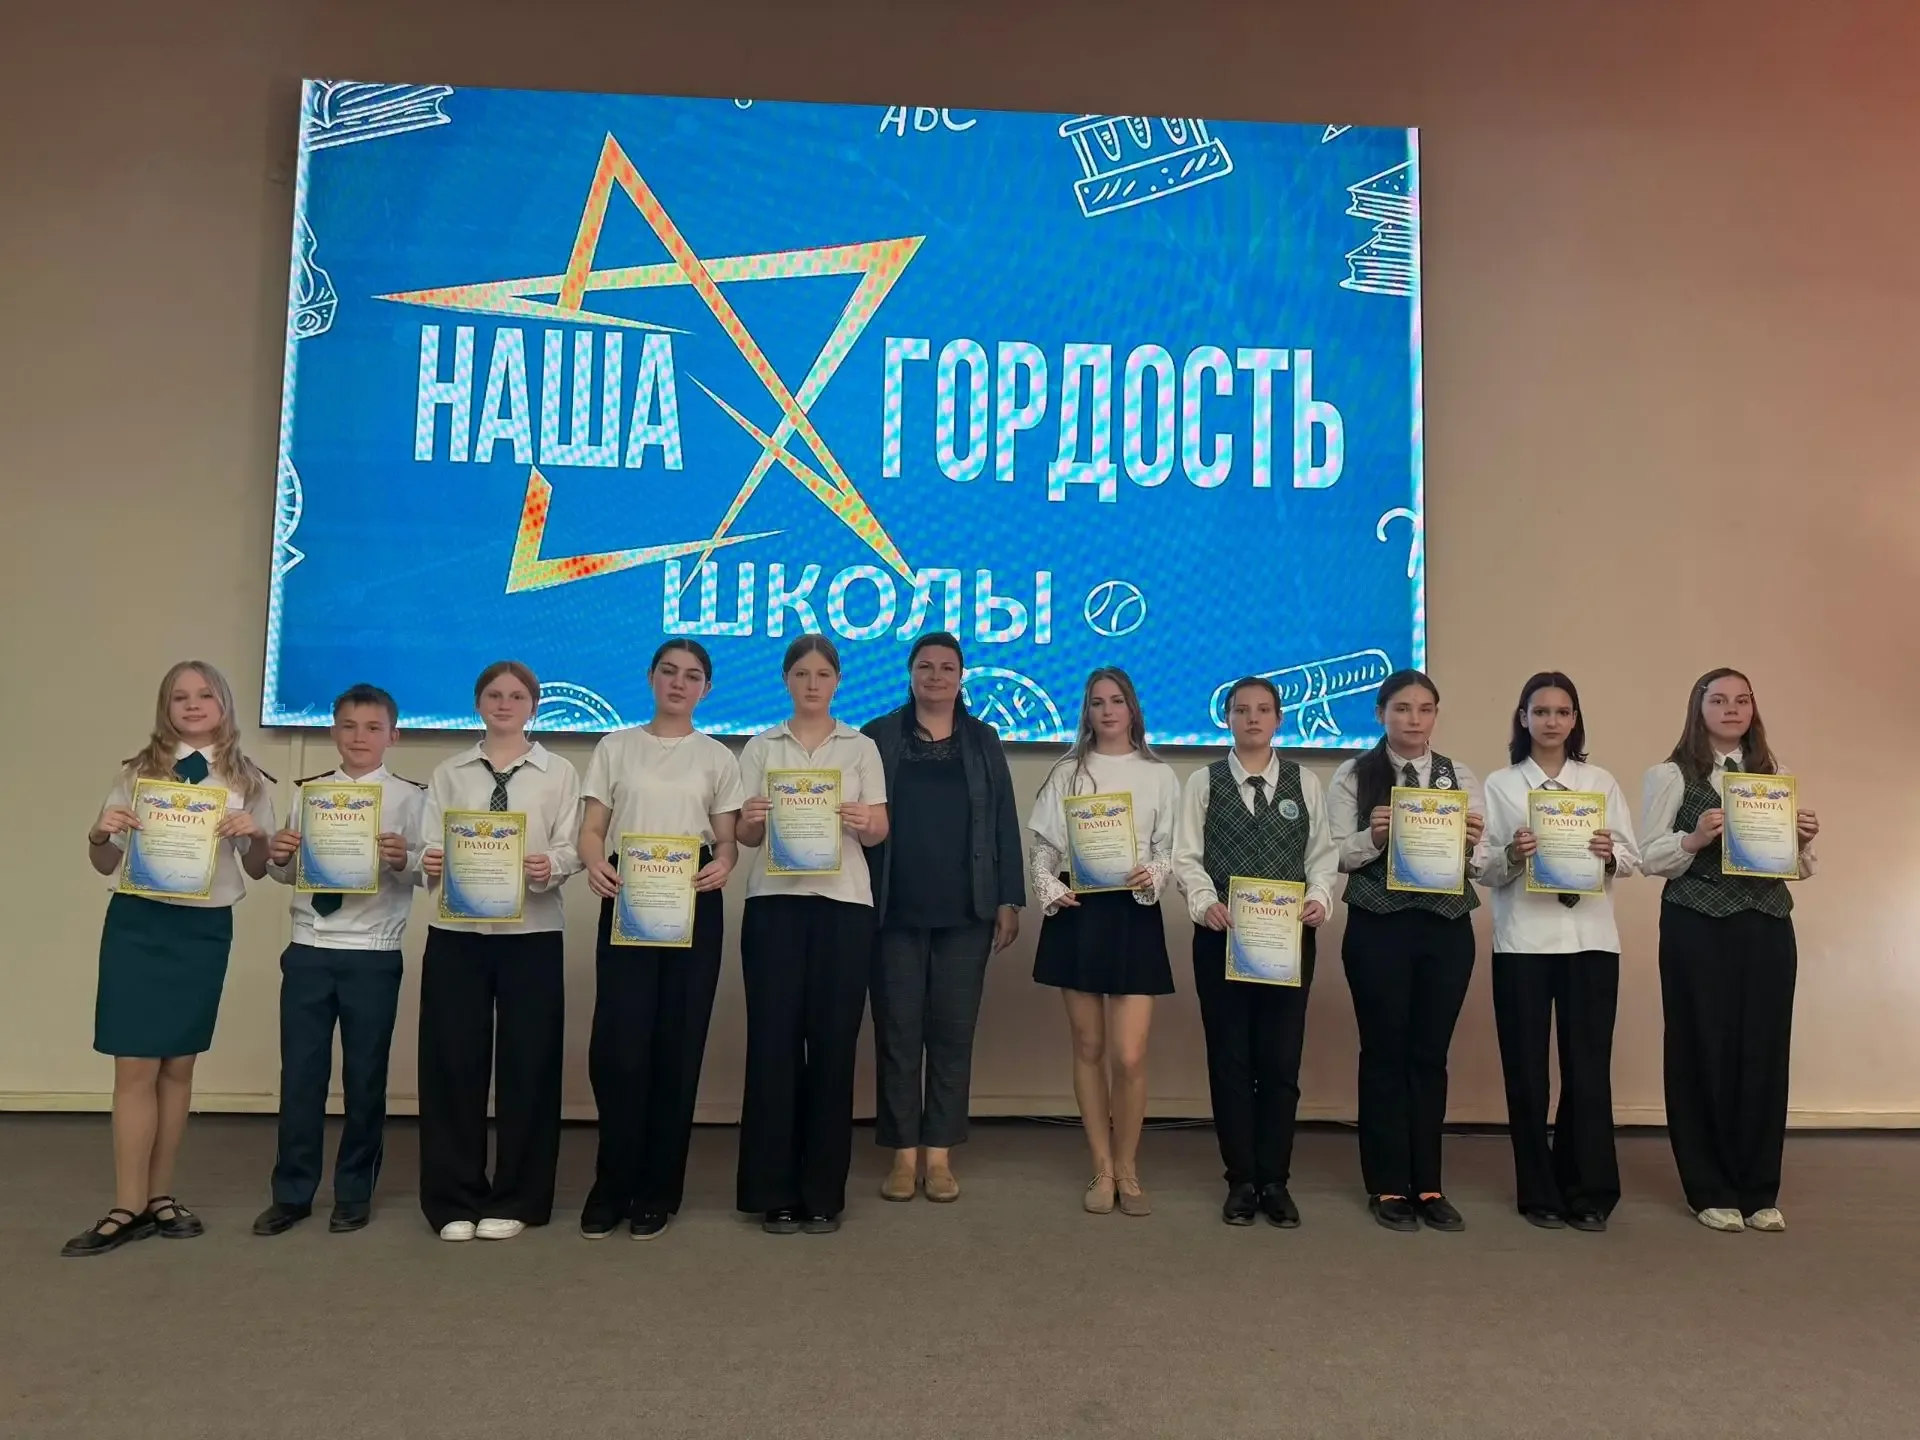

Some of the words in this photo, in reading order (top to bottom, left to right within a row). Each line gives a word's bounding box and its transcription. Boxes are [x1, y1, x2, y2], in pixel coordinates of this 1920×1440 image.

[414, 324, 683, 470] НАША
[882, 337, 1344, 503] ГОРДОСТЬ
[662, 559, 1052, 644] ШКОЛЫ
[780, 797, 828, 806] ГРАМОТА
[1736, 800, 1784, 811] ГРАМОТА
[148, 811, 206, 825] ГРАМОТА
[315, 812, 366, 821] ГРАМОТА
[1404, 816, 1453, 826] ГРАМОТА
[1078, 820, 1122, 830] ГРАМОТА
[1542, 818, 1591, 828] ГРАМОТА
[457, 840, 510, 850] ГРАМОТА
[633, 864, 684, 874] ГРАМОТА
[1242, 905, 1289, 917] ГРАМОТА
